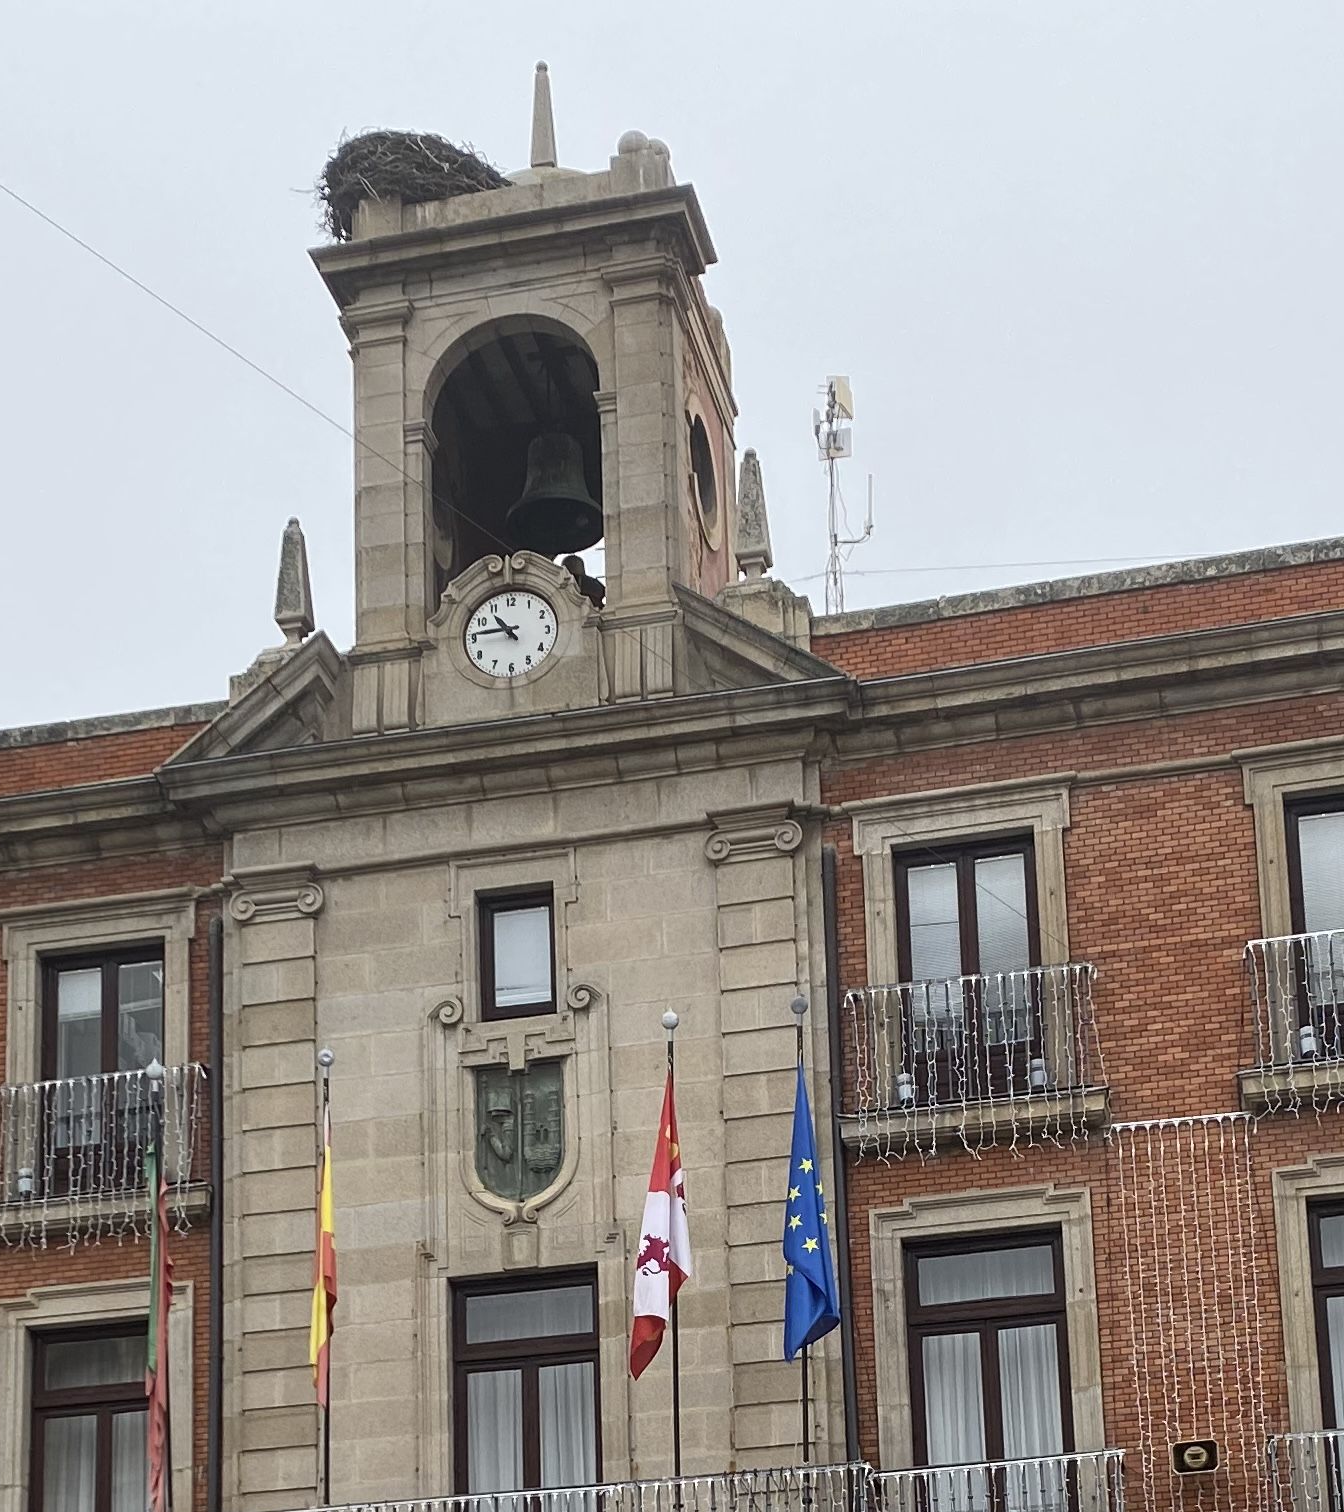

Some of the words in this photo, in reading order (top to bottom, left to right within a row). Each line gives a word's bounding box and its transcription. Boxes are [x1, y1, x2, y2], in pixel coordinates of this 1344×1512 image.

[506, 598, 516, 607] 12
[490, 604, 498, 613] 11
[539, 610, 545, 619] 2
[477, 617, 487, 627] 10
[545, 625, 551, 634] 3
[471, 633, 477, 643] 9
[537, 642, 544, 652] 4
[477, 650, 482, 659] 8
[492, 659, 498, 669] 7
[525, 655, 531, 665] 5
[508, 663, 514, 672] 6
